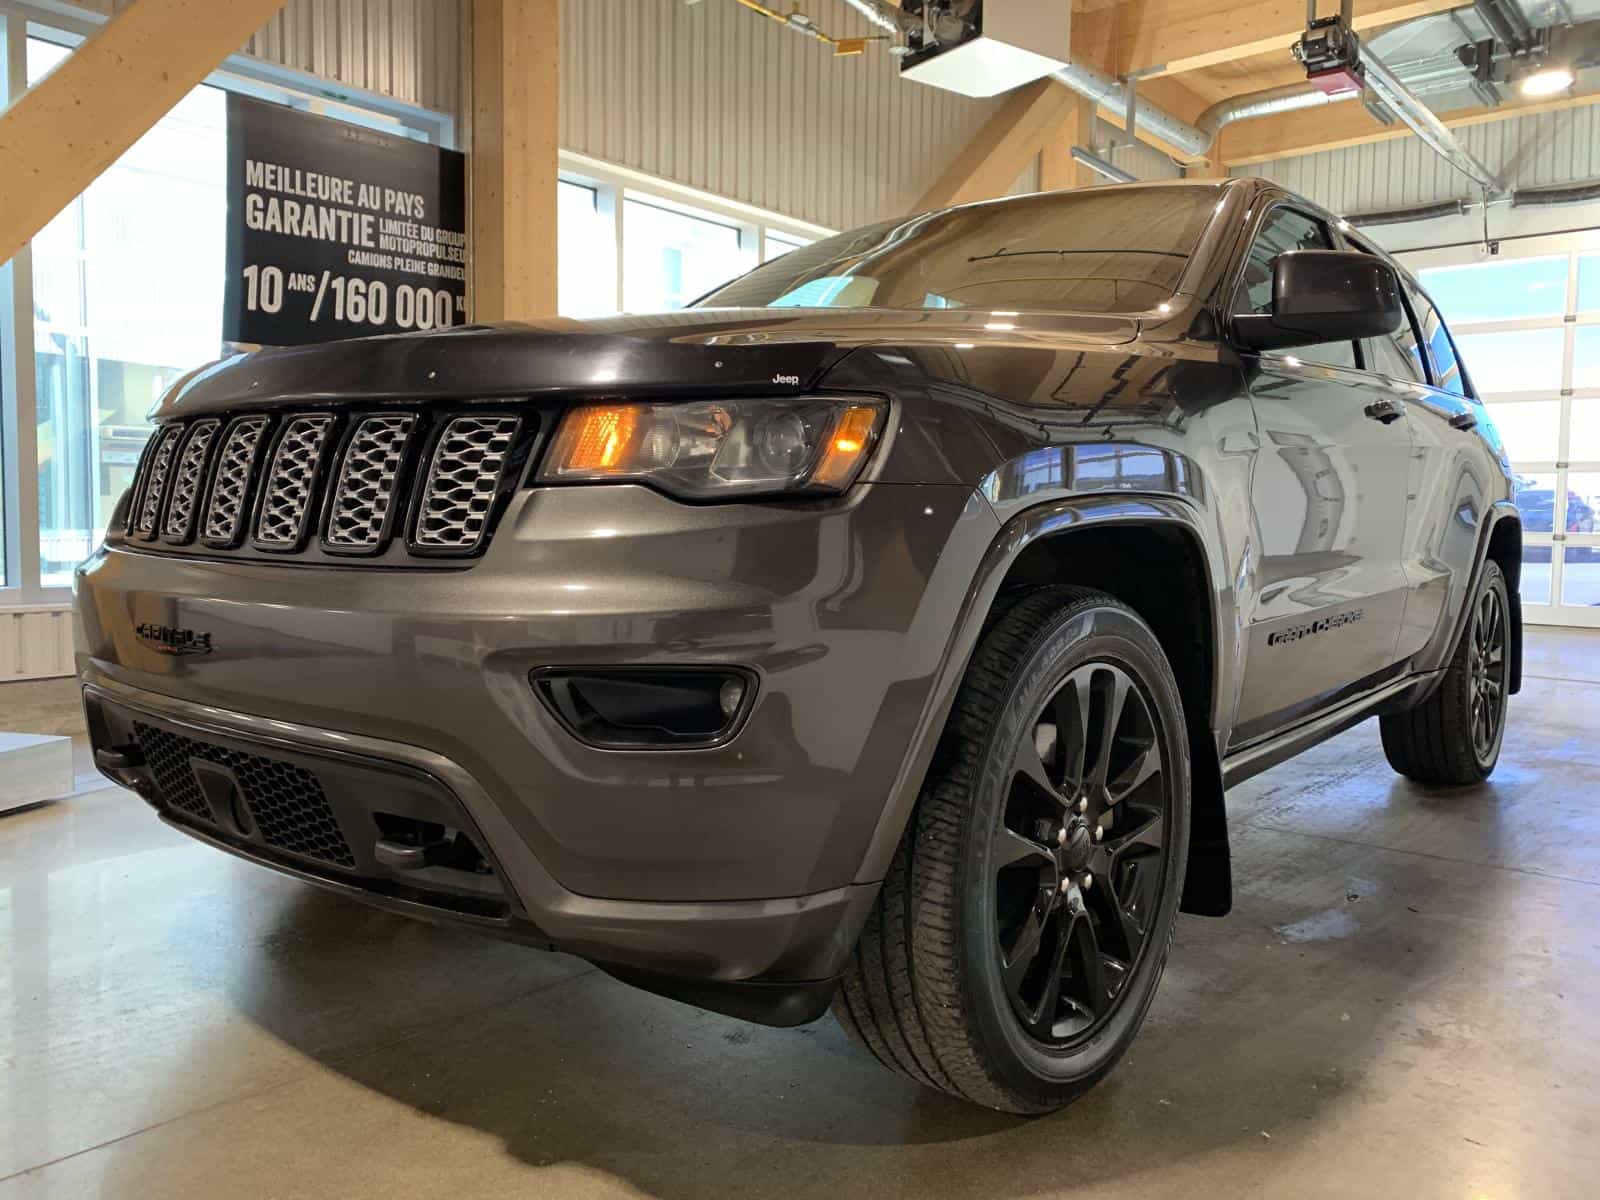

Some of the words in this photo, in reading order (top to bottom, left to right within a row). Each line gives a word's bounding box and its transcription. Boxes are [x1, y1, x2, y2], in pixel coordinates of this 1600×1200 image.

[246, 159, 354, 204] MEILLEURE
[357, 183, 381, 210] AU
[384, 188, 425, 219] PAYS
[246, 193, 375, 247] GARANTIE
[379, 217, 420, 240] LIMITÉE
[420, 225, 434, 242] DU
[347, 249, 393, 270] CAMIONS
[394, 257, 427, 275] PLEINE
[243, 265, 283, 313] 10
[287, 272, 316, 293] ANS
[395, 284, 453, 330] 000
[772, 373, 799, 386] Jeep
